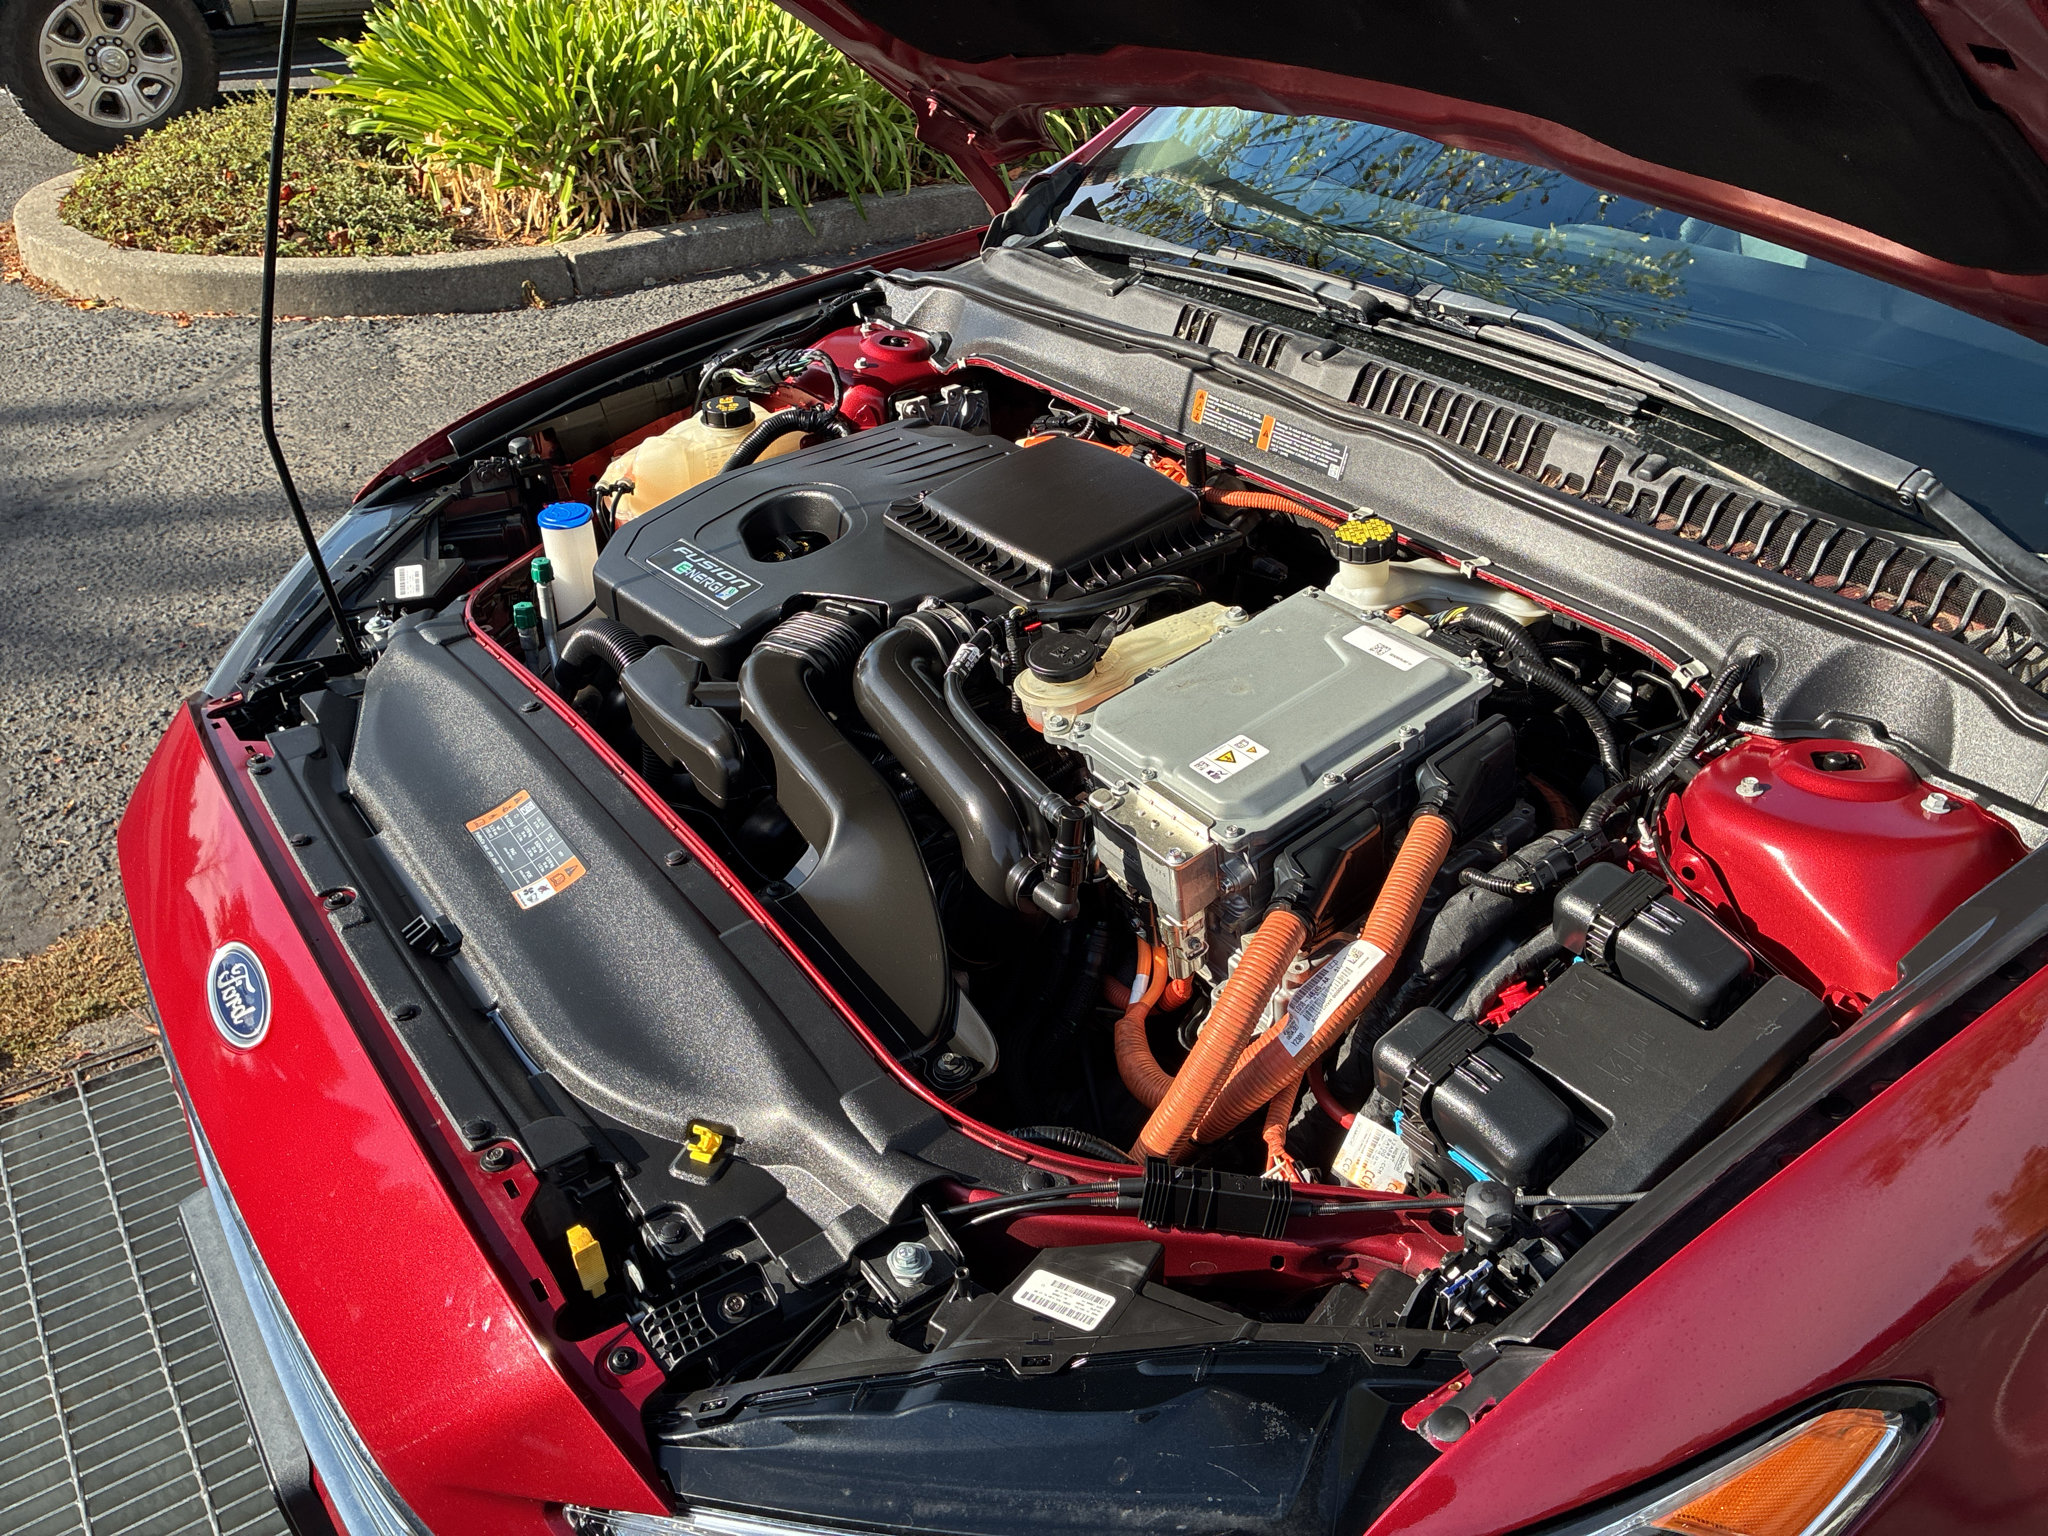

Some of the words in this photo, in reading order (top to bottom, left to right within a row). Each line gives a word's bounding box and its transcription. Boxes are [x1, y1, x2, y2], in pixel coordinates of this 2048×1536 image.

[673, 547, 752, 589] FUSION
[217, 962, 256, 1025] Ford
[1358, 1168, 1375, 1189] CCH
